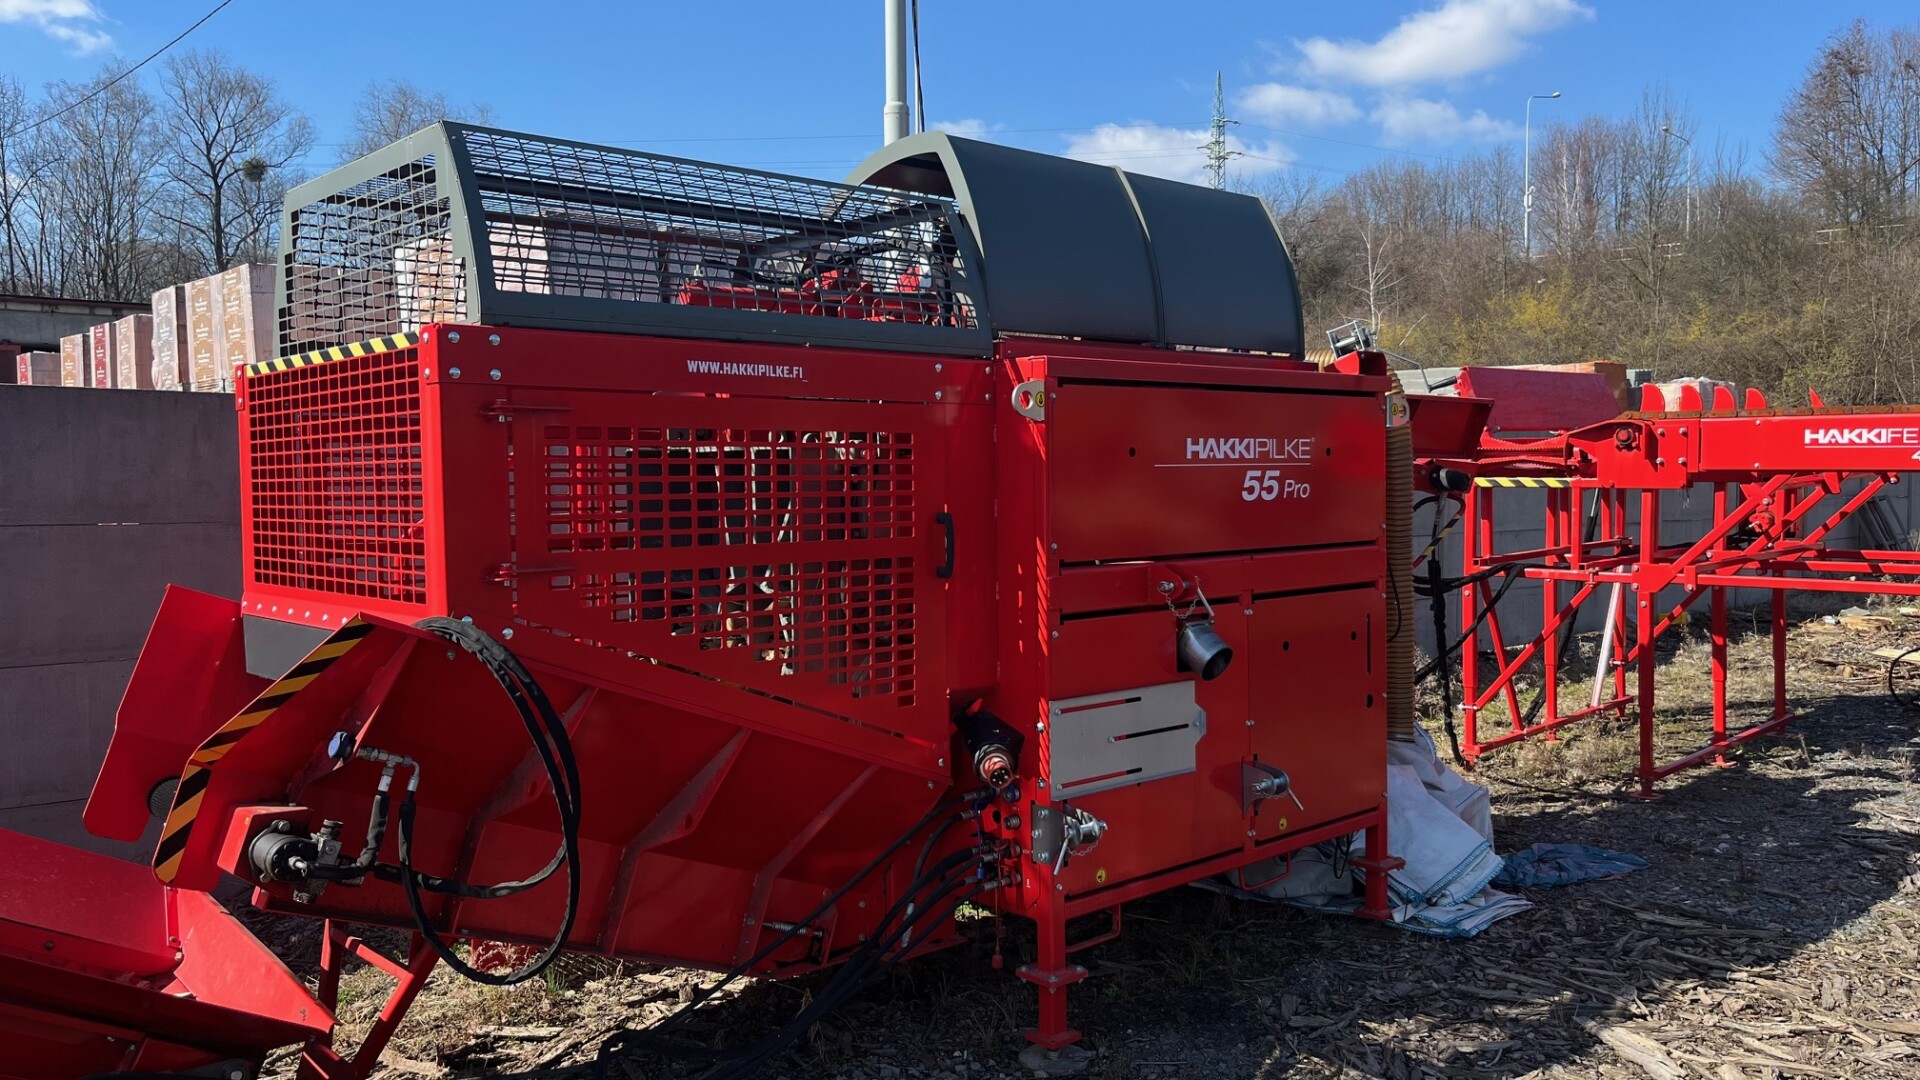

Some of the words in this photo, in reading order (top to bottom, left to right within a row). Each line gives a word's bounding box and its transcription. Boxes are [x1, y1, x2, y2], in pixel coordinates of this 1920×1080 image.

[687, 360, 803, 379] WWW.HAKKIPILKE.FI
[1186, 437, 1311, 459] HAKKIPILKE
[1241, 470, 1280, 501] 55
[1283, 480, 1310, 499] Pro
